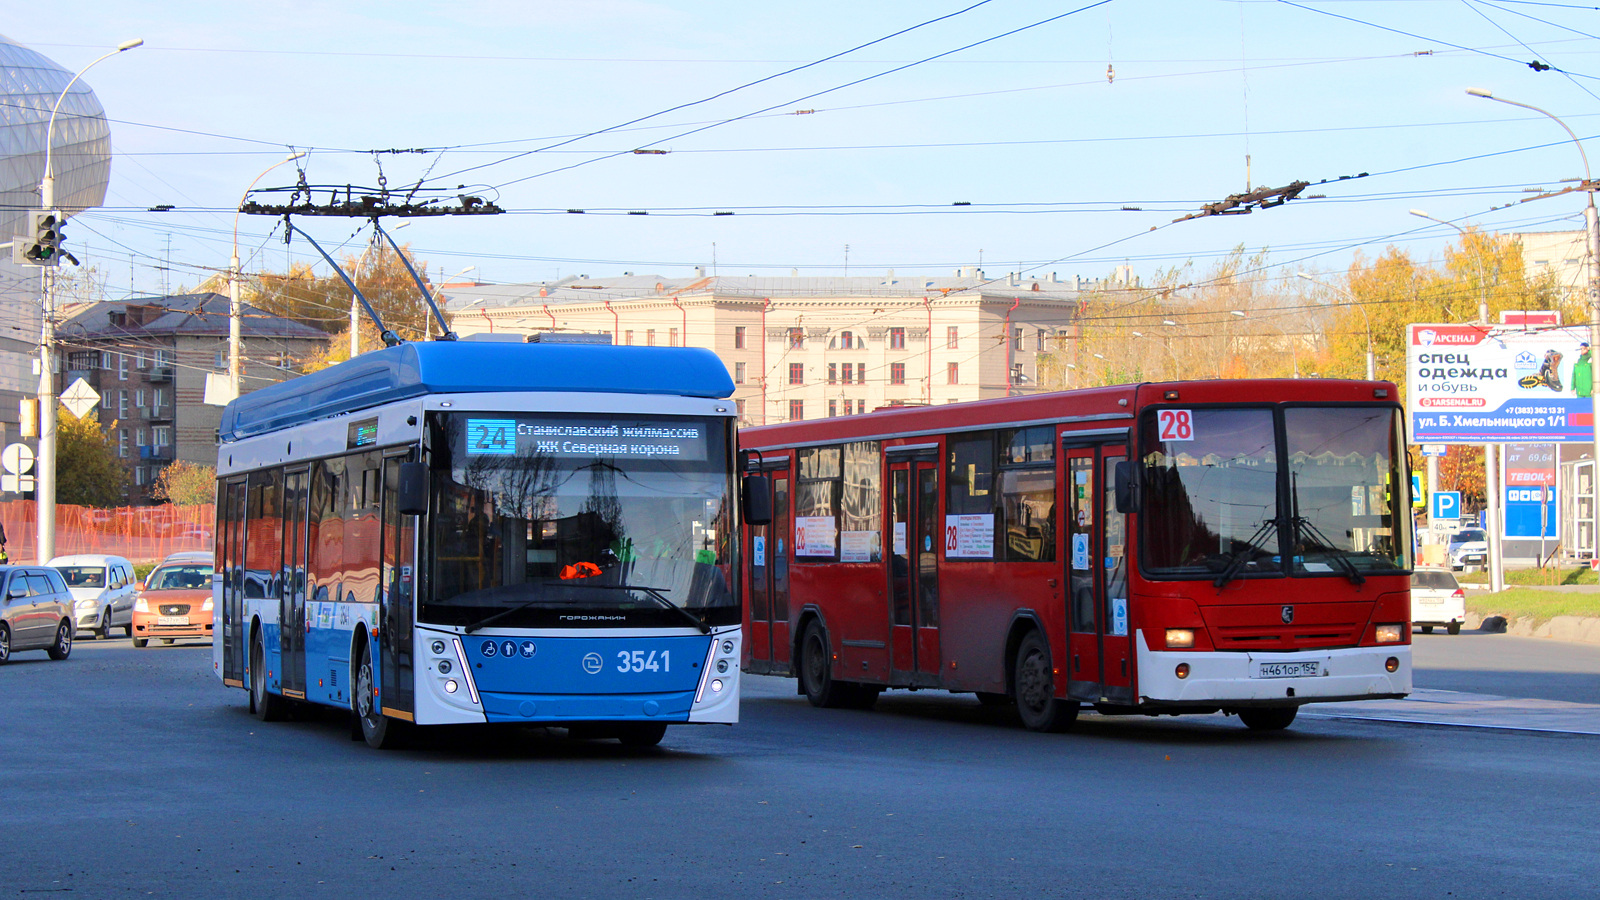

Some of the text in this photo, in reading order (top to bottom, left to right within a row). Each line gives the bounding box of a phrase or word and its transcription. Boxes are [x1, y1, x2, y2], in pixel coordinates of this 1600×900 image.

[1435, 334, 1476, 343] АРСЕНАЛ
[1418, 353, 1470, 366] спец
[1418, 367, 1508, 380] одежда
[1418, 381, 1478, 394] и обувь
[1432, 399, 1483, 407] 1ARSENAL.RU
[1515, 406, 1534, 415] (383)
[1159, 410, 1192, 439] 28
[1418, 415, 1566, 429] ул. Б. Хмельницкого 1/1
[476, 424, 508, 449] 24
[517, 423, 699, 439] Станиславский жилмассив
[536, 440, 680, 457] ЖК Северная корона
[1438, 495, 1454, 517] P
[796, 526, 806, 550] 28
[946, 525, 958, 551] 28
[616, 650, 670, 673] 3541
[1262, 663, 1316, 676] Н461ОР 154
